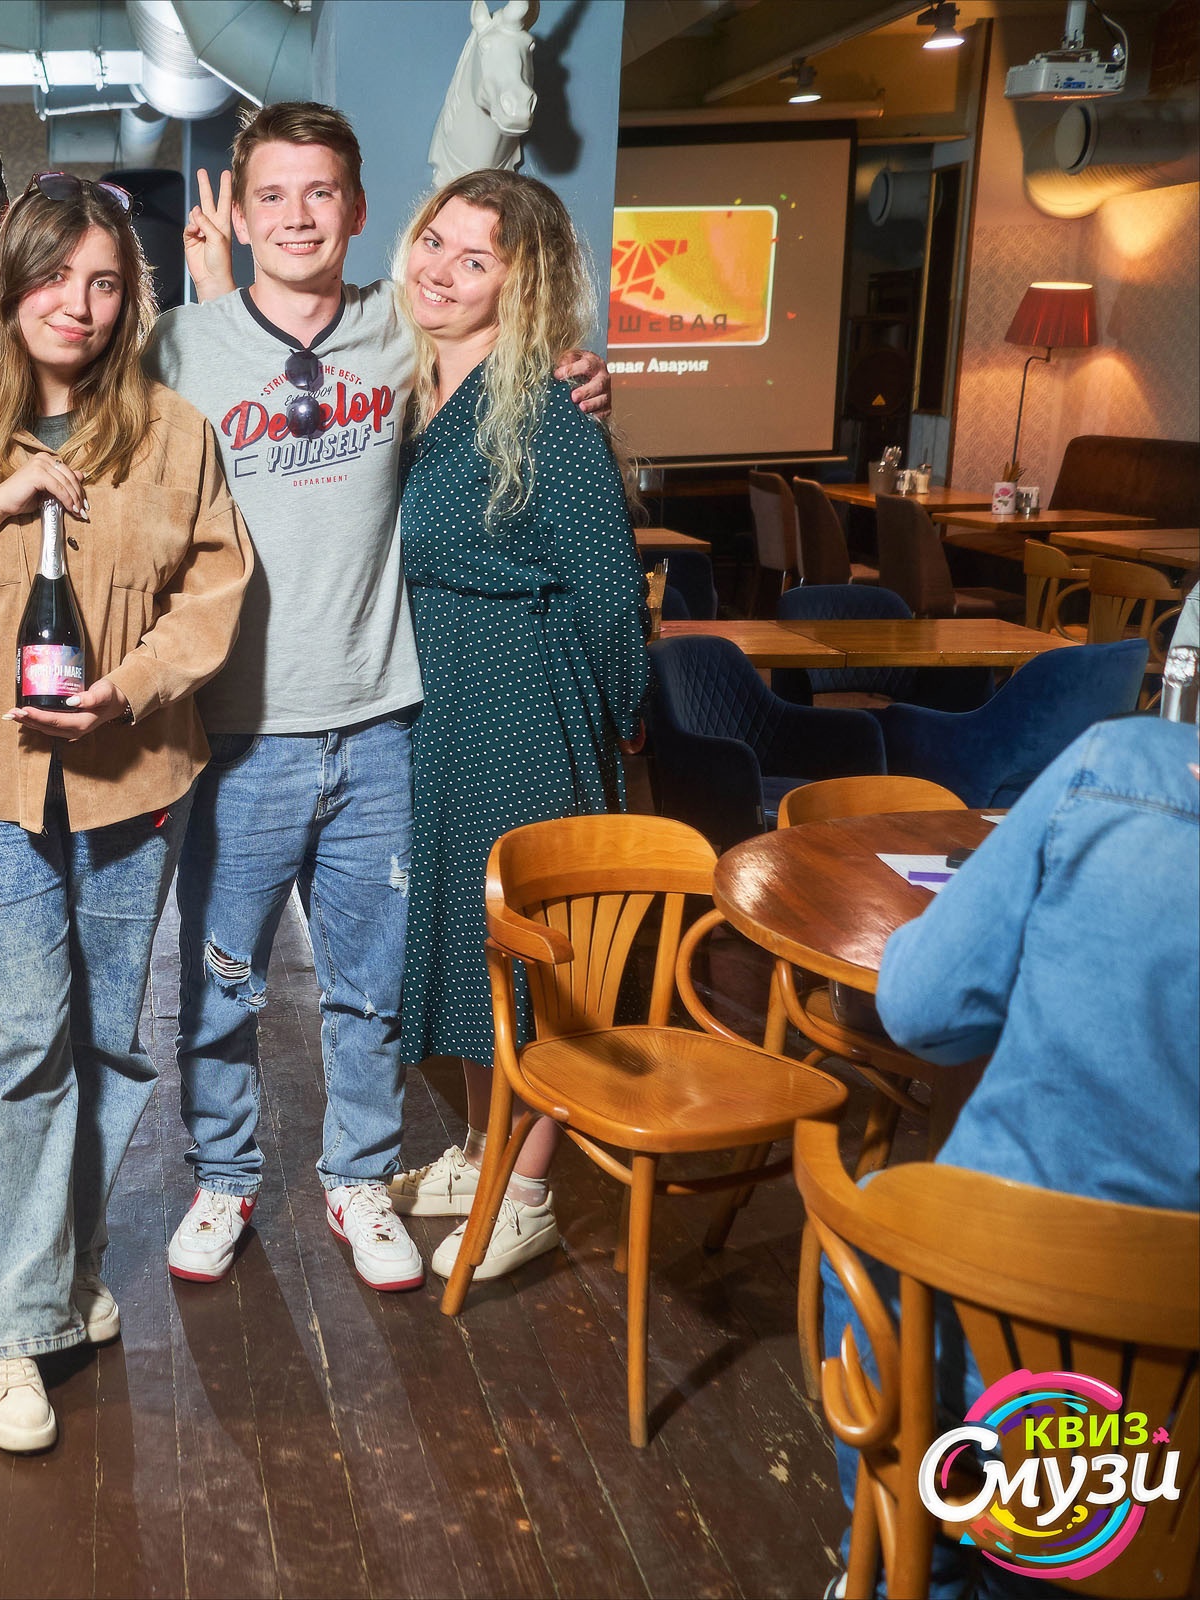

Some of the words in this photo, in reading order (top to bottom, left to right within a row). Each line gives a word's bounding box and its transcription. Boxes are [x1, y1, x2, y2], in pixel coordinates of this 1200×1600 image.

[608, 314, 728, 333] ШЕВАЯ
[647, 358, 709, 375] Авария
[338, 369, 362, 385] BEST
[220, 381, 396, 451] Deelop
[266, 424, 373, 473] YOURSELF
[293, 474, 349, 487] DEPARTMENT
[64, 665, 82, 679] MARE
